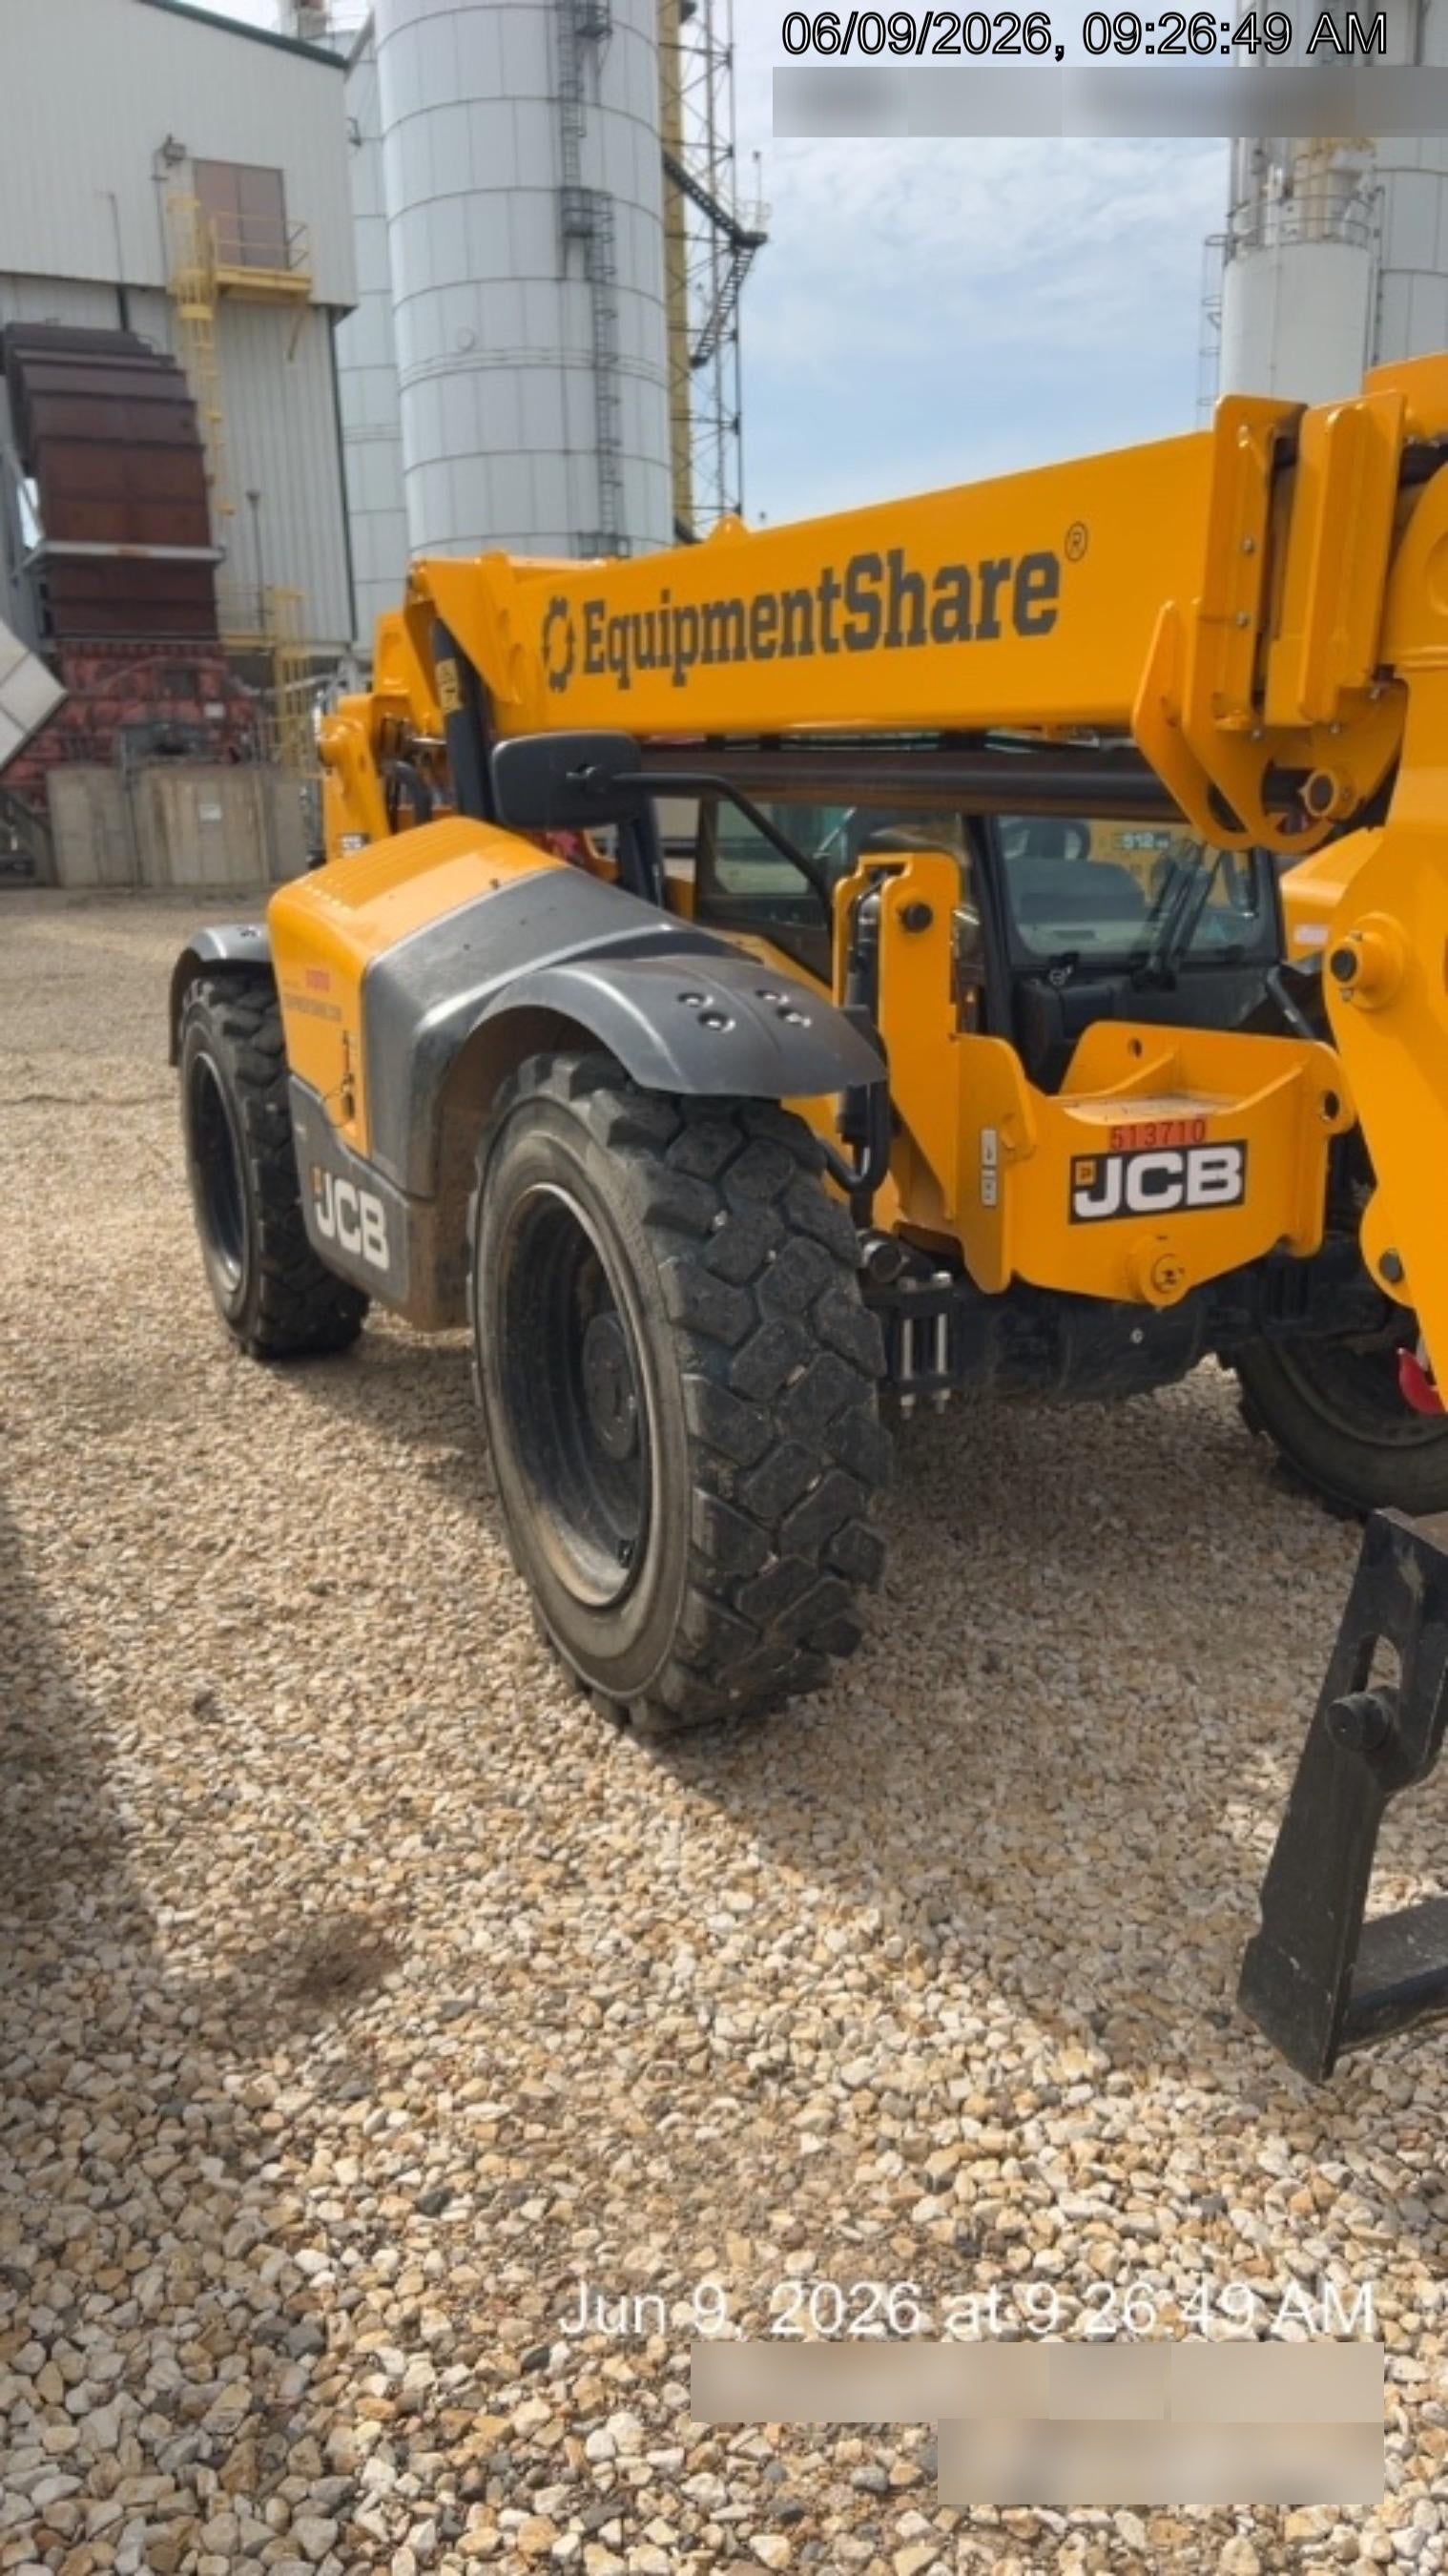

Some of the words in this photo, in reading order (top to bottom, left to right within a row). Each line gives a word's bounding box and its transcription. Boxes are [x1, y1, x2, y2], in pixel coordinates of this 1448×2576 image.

[1109, 1119, 1206, 1151] 513710
[1073, 1146, 1242, 1218] JCB
[312, 1167, 389, 1270] JCB
